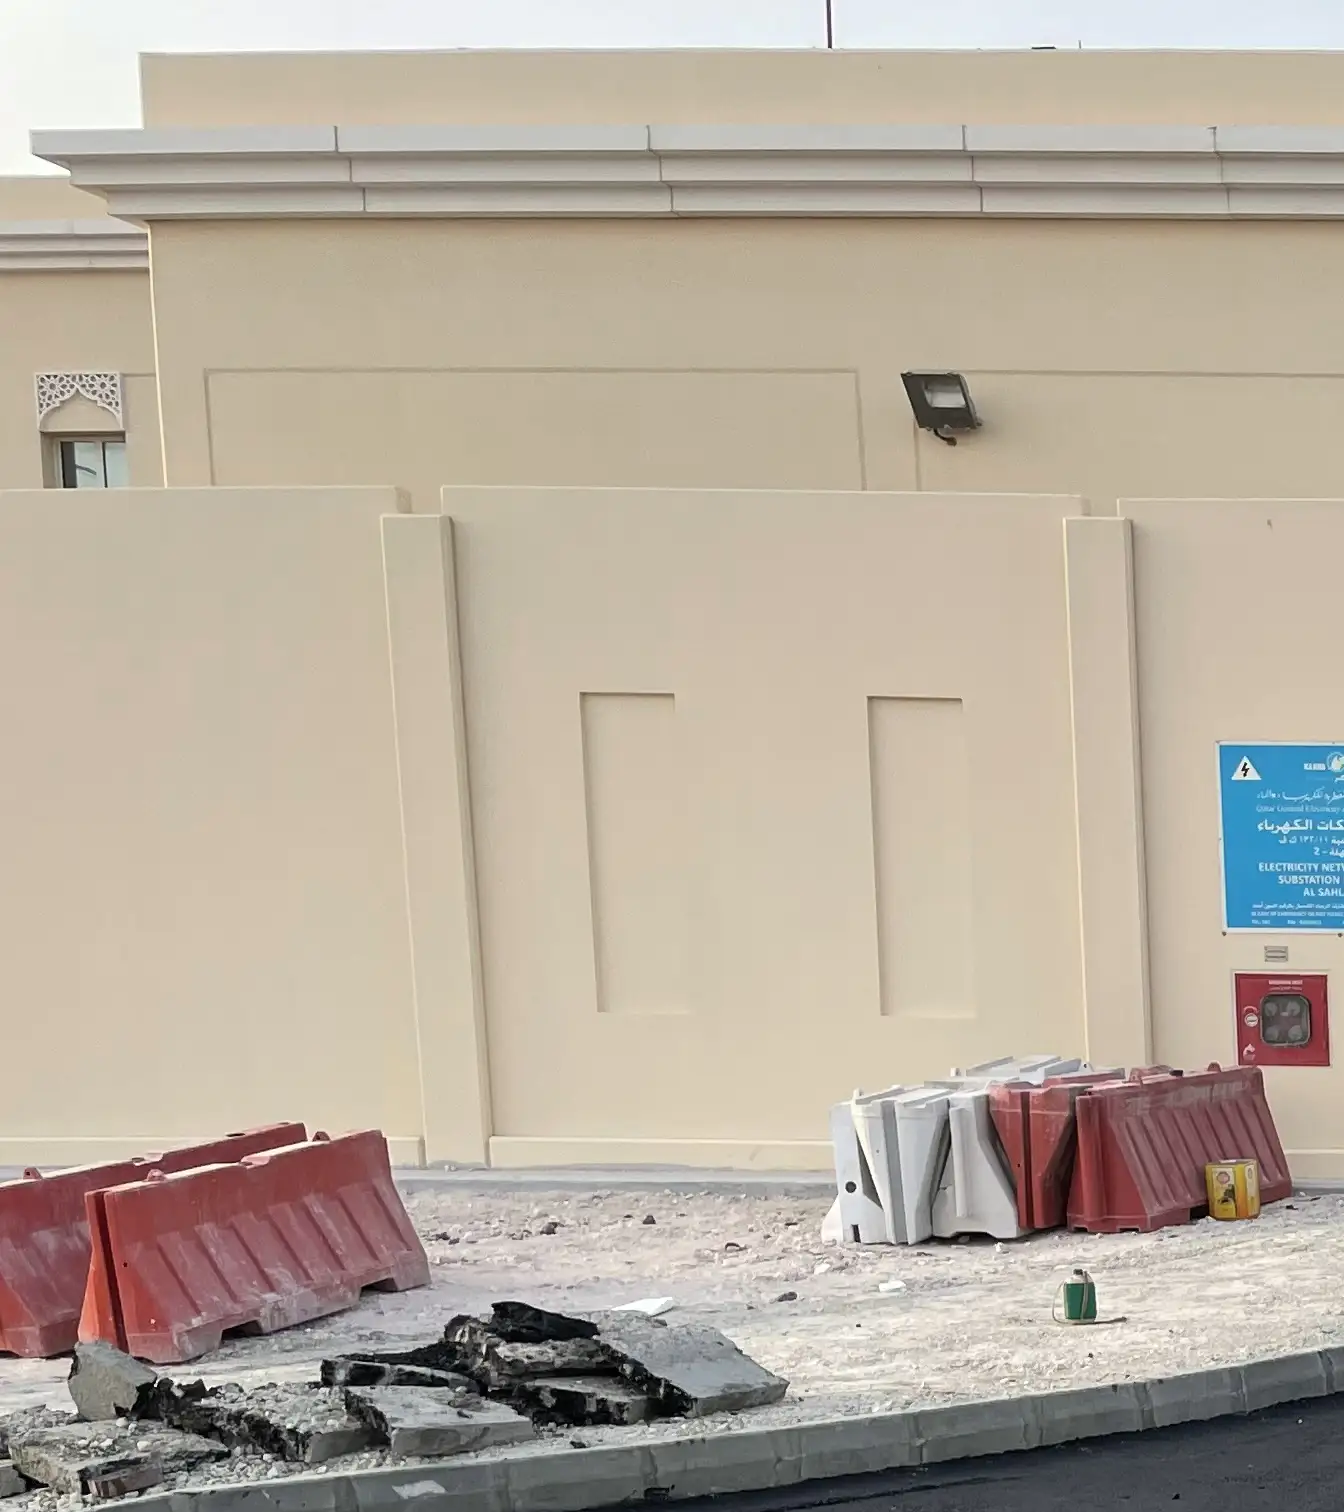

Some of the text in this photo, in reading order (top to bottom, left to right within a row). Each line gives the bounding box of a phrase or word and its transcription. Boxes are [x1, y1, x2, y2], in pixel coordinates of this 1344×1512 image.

[1257, 818, 1313, 834] الكهرباء
[1258, 862, 1319, 872] ELECTRICITY
[1278, 875, 1340, 885] SUBSTATION
[1303, 887, 1316, 897] AL
